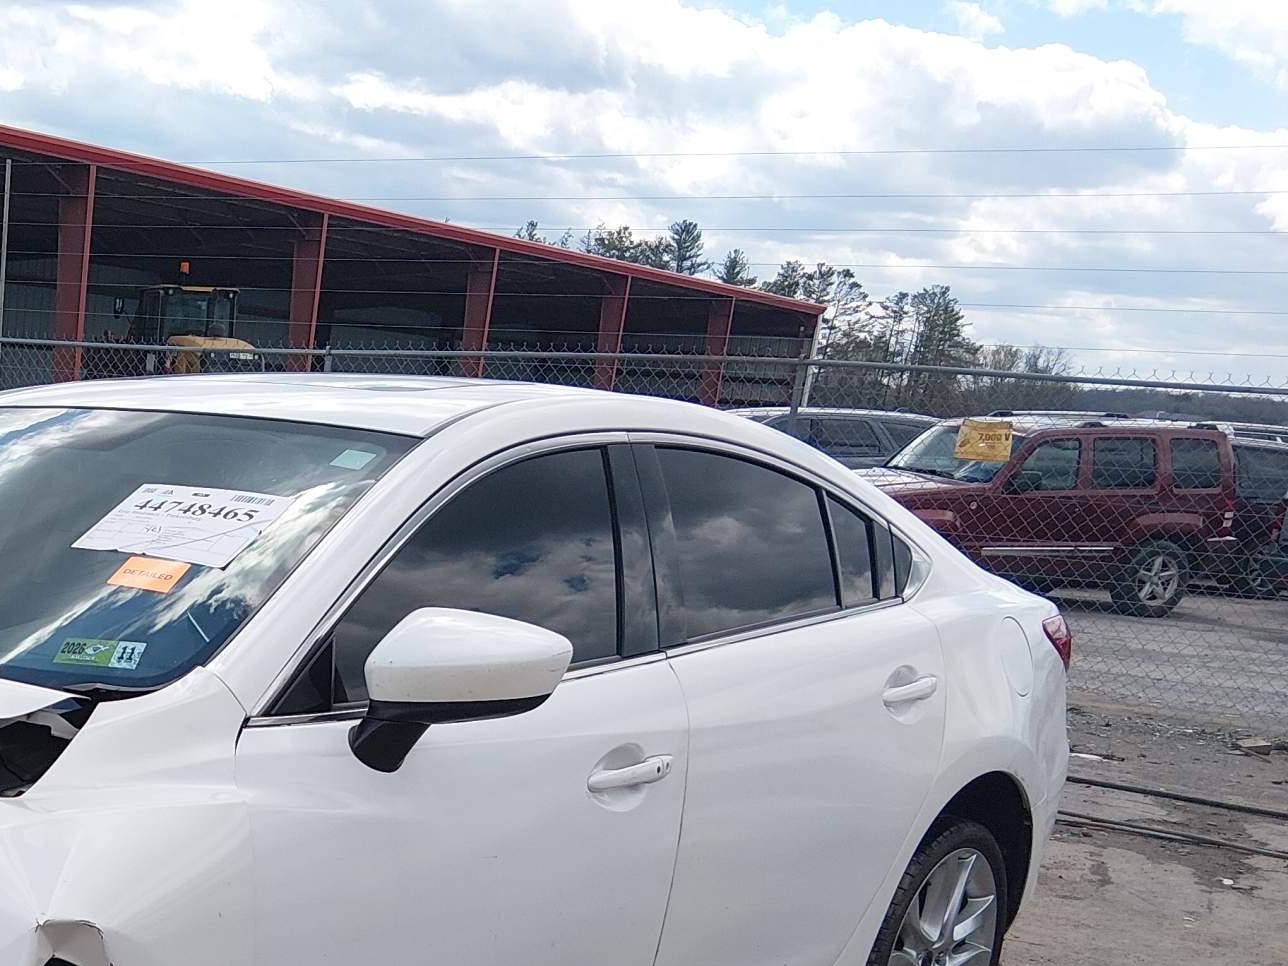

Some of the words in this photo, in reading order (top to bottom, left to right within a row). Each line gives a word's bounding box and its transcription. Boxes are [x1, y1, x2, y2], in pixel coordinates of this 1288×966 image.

[133, 499, 261, 522] 44748465
[122, 568, 174, 581] DETAILED
[60, 641, 87, 655] 2026
[117, 645, 137, 661] 11
